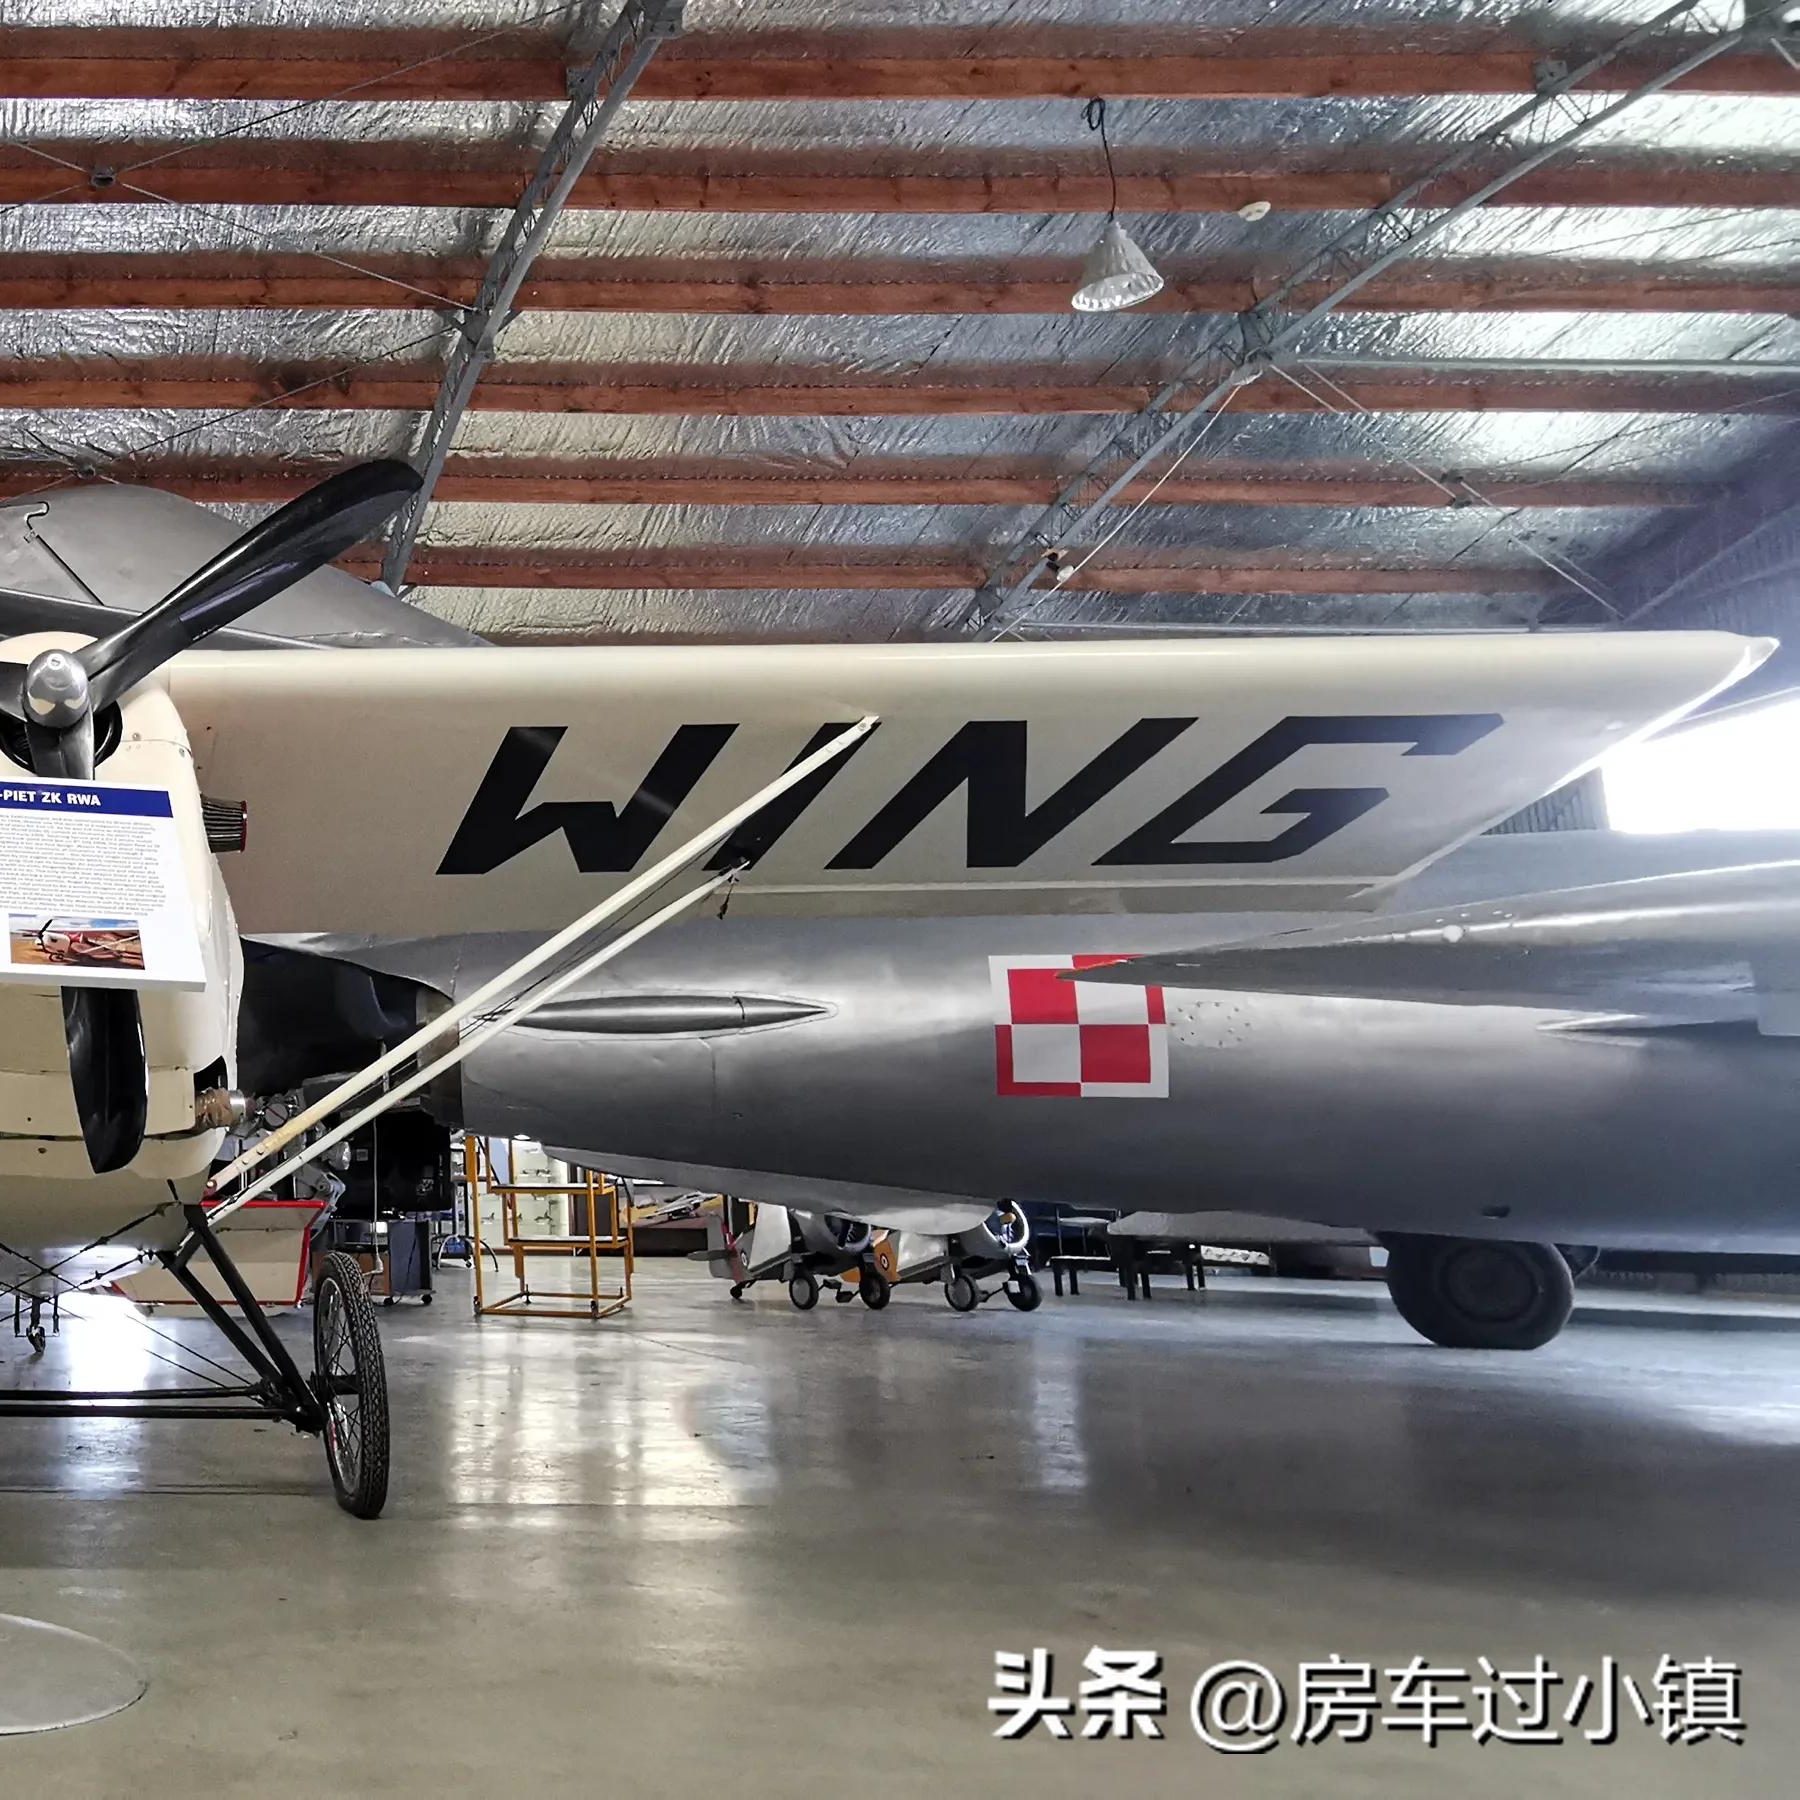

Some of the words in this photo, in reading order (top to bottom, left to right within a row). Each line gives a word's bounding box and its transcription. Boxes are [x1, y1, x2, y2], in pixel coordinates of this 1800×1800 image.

[41, 791, 62, 804] ZK
[66, 793, 101, 806] RWA
[435, 712, 1504, 875] WING
